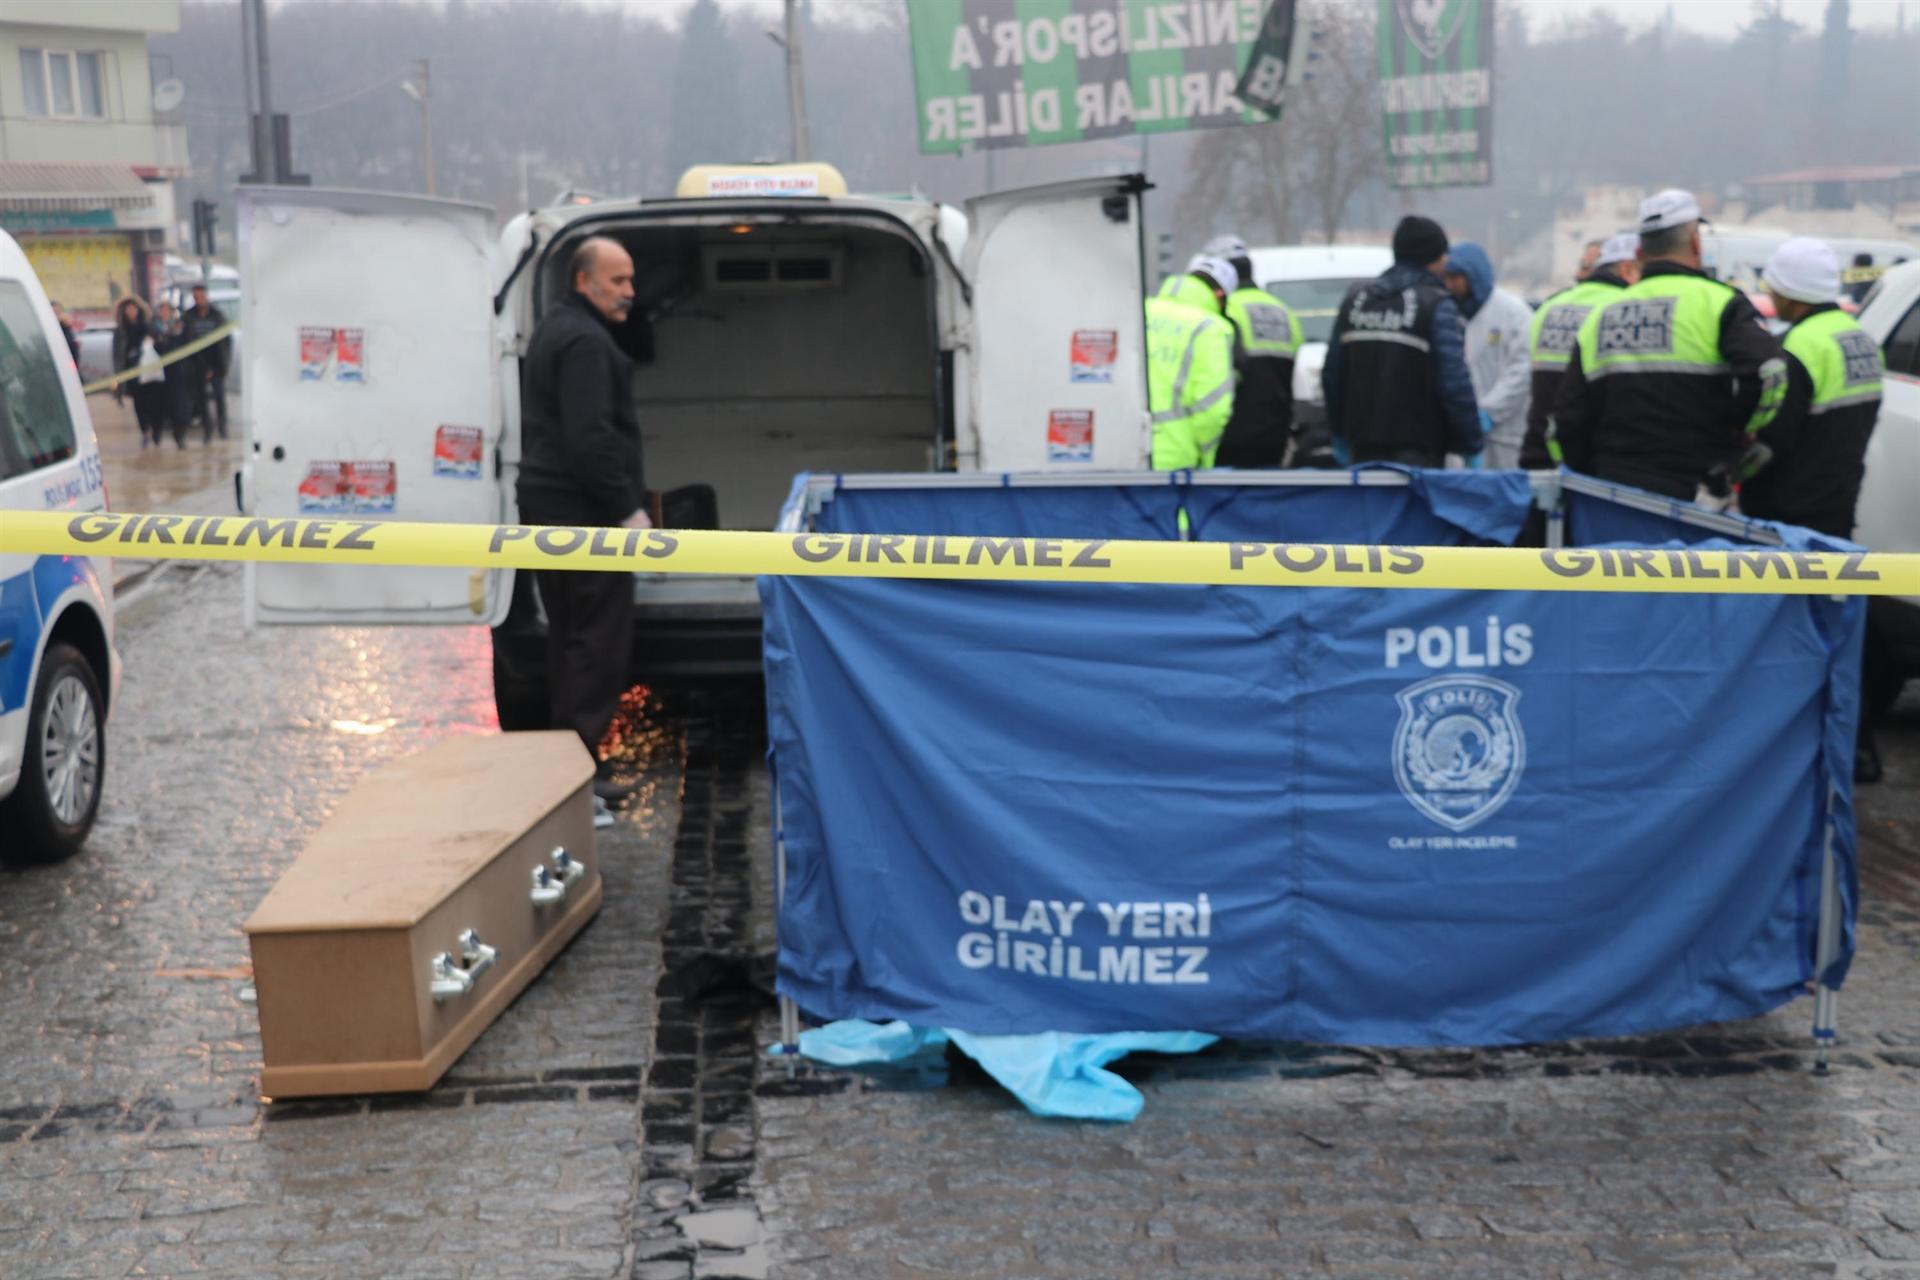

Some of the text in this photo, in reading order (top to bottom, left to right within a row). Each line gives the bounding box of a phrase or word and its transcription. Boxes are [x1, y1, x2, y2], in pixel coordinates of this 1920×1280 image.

[1385, 615, 1534, 668] POLİS
[958, 890, 1212, 938] OLAY YERİ
[957, 931, 1209, 984] GİRİLMEZ
